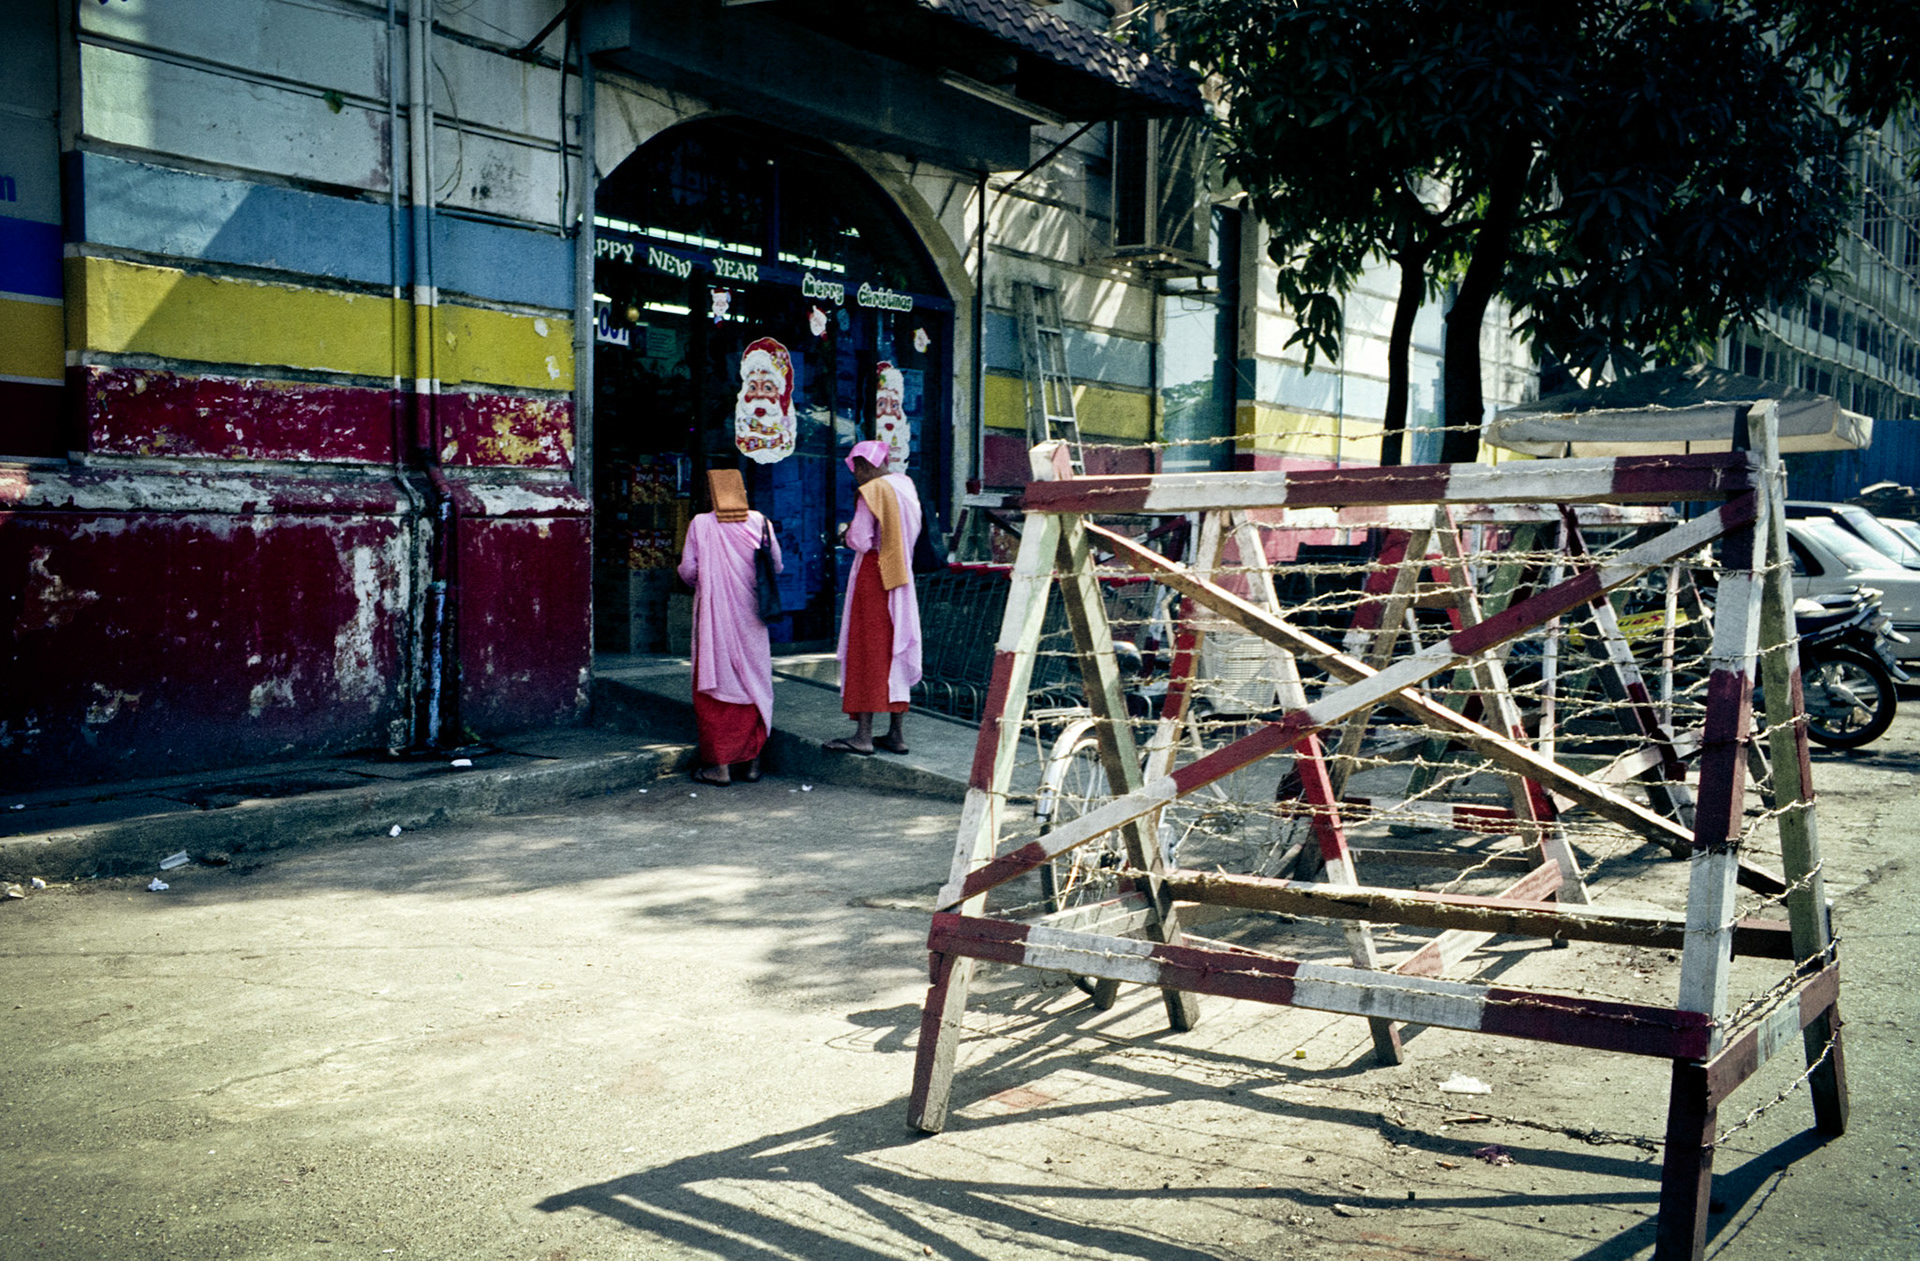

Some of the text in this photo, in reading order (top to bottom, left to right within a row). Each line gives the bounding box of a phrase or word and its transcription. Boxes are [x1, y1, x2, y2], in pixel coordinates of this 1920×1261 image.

[594, 238, 759, 282] PPY NEW YEAR
[802, 273, 913, 312] Merry Christmas
